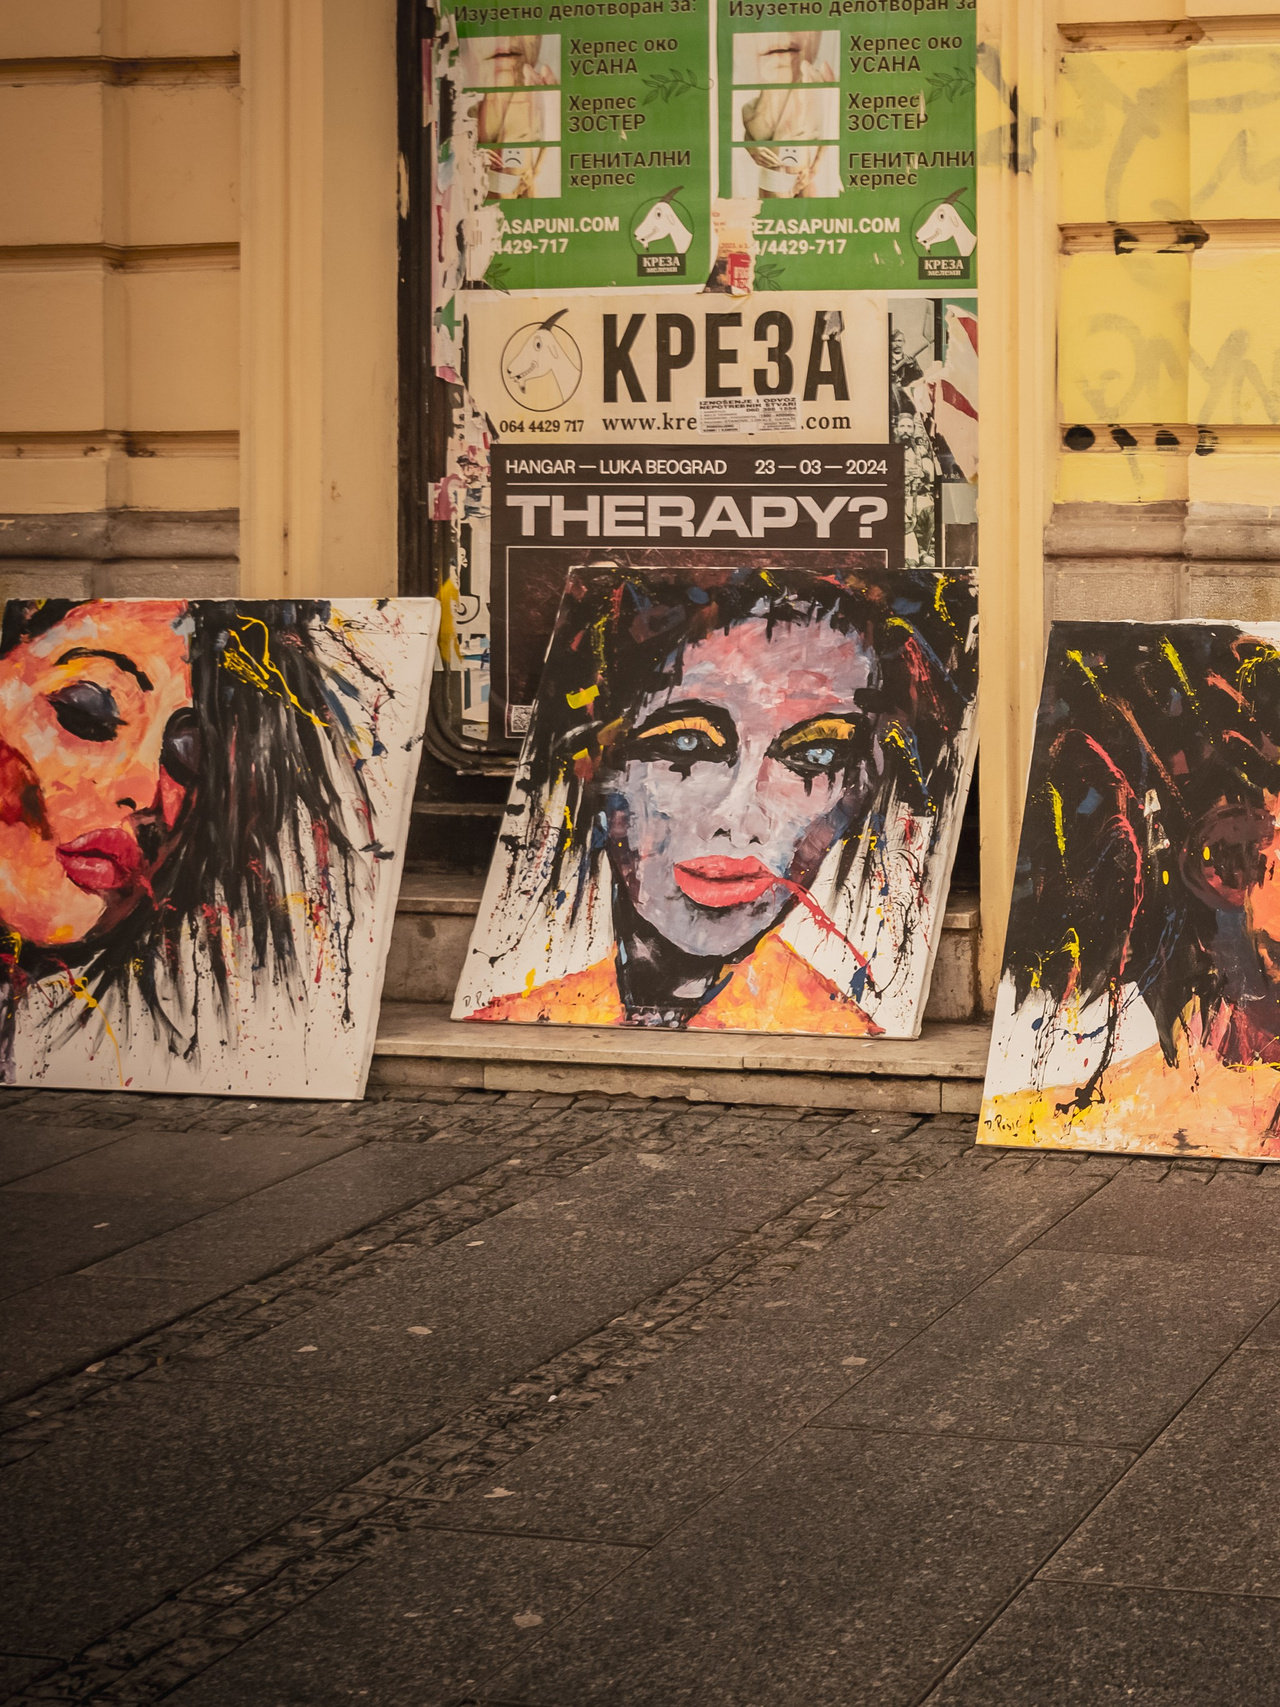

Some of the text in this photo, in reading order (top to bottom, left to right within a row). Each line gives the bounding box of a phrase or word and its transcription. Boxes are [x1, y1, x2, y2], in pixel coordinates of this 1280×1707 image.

[455, 0, 696, 25] Изузетно делотворан за:
[730, 1, 823, 20] Изузетно
[829, 0, 948, 17] делотворан
[568, 38, 678, 58] Херпес око
[850, 34, 962, 54] Херпес око
[569, 58, 638, 77] УСАНА
[850, 55, 921, 73] УСАНА
[568, 95, 637, 115] Херпес
[848, 92, 920, 113] Херпес
[568, 114, 646, 133] ЗОСТЕР
[848, 113, 928, 131] ЗОСТЕР
[569, 150, 691, 170] ГЕНИТАЛНИ
[849, 151, 975, 170] ГЕНИТАЛНИ
[569, 172, 636, 191] херпес
[849, 172, 918, 190] херпес
[501, 216, 619, 235] ASAPUNI.COM
[753, 217, 900, 235] EZASAPUNI.COM
[494, 238, 569, 254] 4429-717
[753, 239, 847, 256] 4/4429-717
[643, 256, 680, 267] КРЕЗА
[924, 259, 964, 270] КРЕЗА
[602, 310, 850, 403] КРЕЗА
[500, 420, 584, 433] 064 4429 717
[505, 459, 576, 474] HANGAR
[600, 459, 643, 475] LUKA
[645, 459, 728, 475] BEOGRAD
[755, 459, 776, 475] 23
[799, 459, 822, 475] 03
[845, 459, 888, 475] 2024
[506, 495, 888, 538] THERAPY?
